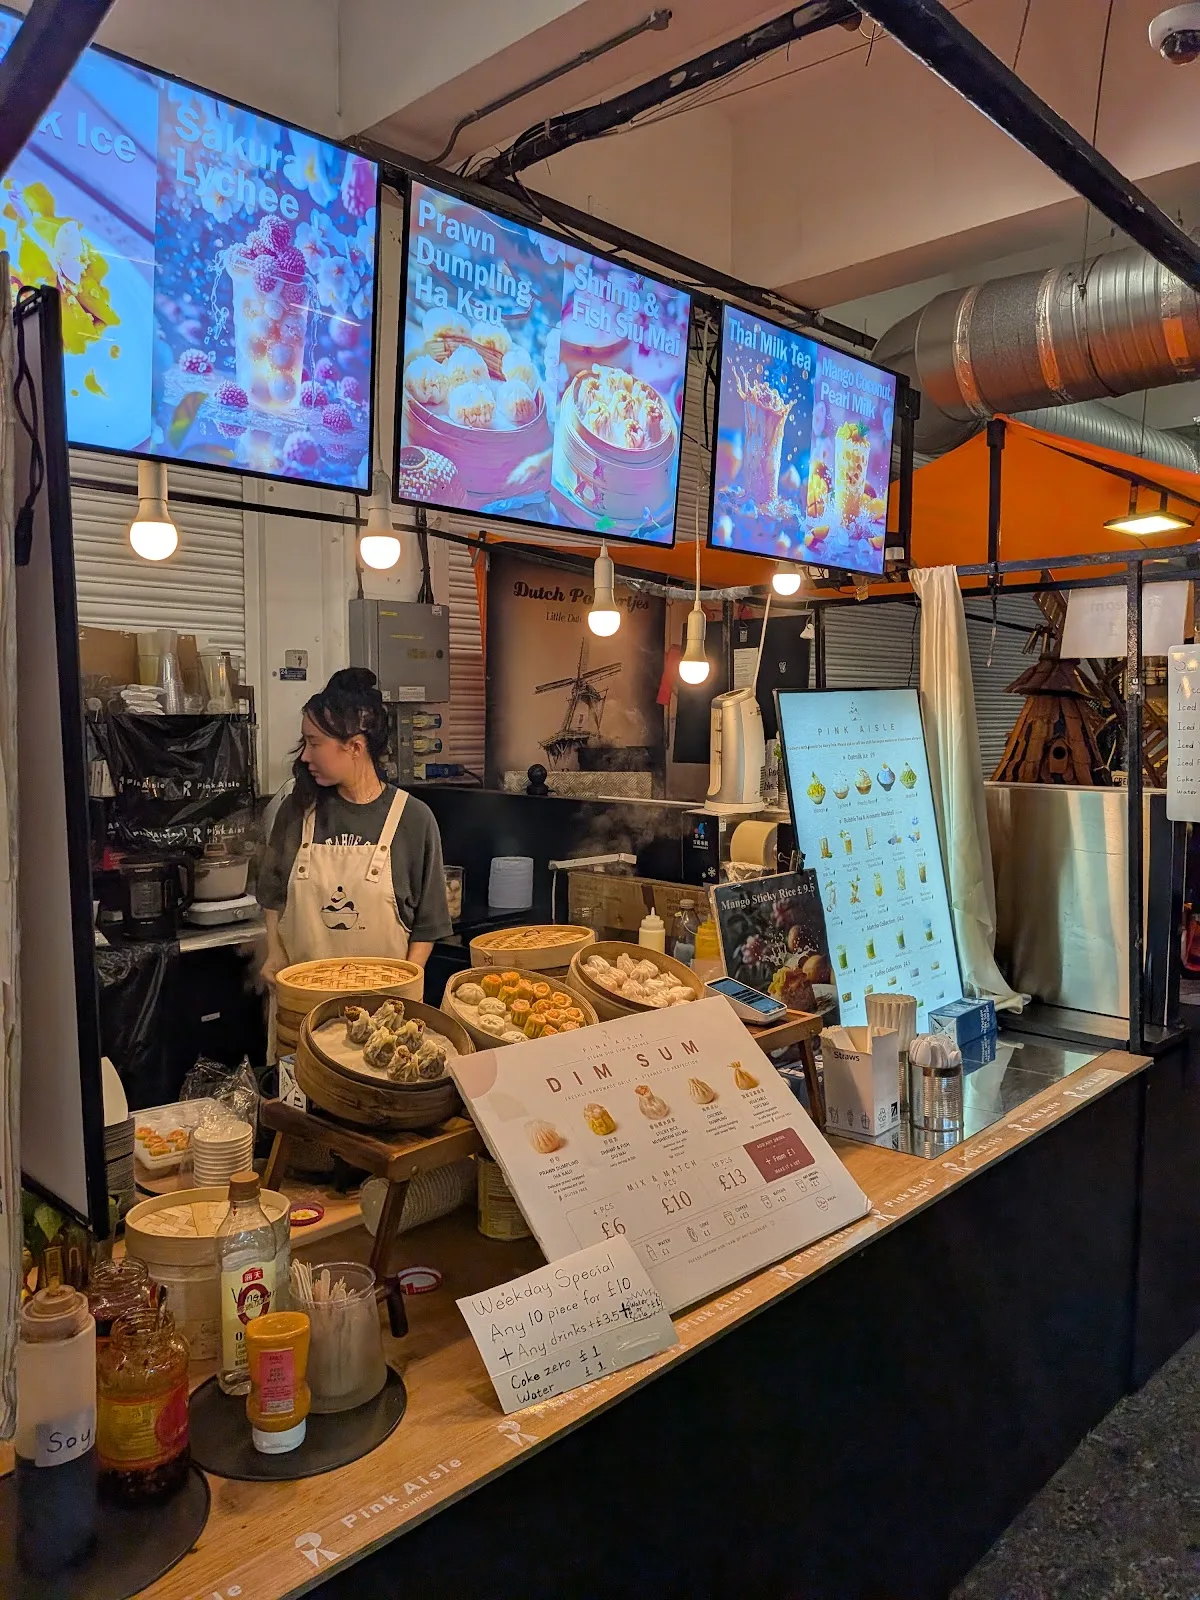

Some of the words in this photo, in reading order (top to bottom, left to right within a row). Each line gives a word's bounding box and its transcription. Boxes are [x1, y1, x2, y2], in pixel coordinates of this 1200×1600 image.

[77, 111, 137, 162] Ice
[175, 105, 308, 190] Sakura
[176, 147, 300, 220] Lychee
[418, 199, 495, 254] Prawn
[416, 236, 533, 308] Dumpling
[415, 272, 448, 308] Ha
[457, 286, 503, 326] Kau
[573, 264, 641, 312] Shrimp
[643, 292, 660, 319] &
[572, 298, 611, 333] Fish
[615, 311, 644, 345] Siu
[647, 322, 681, 357] Mai
[728, 317, 757, 350] Thai
[759, 330, 788, 362] Milk
[791, 342, 811, 371] Tea
[822, 356, 853, 388] Mango
[820, 382, 850, 410] Pearl
[852, 393, 876, 419] Milk
[513, 581, 565, 602] Dutch
[817, 725, 849, 735] PINK
[858, 722, 895, 733] AISLE
[721, 897, 750, 911] Mango
[751, 891, 777, 907] Sticky
[779, 887, 796, 900] Rice
[803, 882, 815, 894] 9.5
[546, 1063, 613, 1094] DIM
[636, 1039, 700, 1068] SUM
[834, 1050, 861, 1062] Straws
[720, 1156, 733, 1165] PCS
[773, 1152, 787, 1163] From
[626, 1179, 646, 1192] MIX
[663, 1160, 697, 1177] MATCH
[664, 1178, 677, 1188] PCS
[718, 1168, 747, 1191] £13
[599, 1203, 614, 1213] PCS
[661, 1190, 692, 1215] £10
[884, 1190, 910, 1208] Pink
[909, 1177, 936, 1194] Aisle
[601, 1216, 626, 1239] £6
[792, 1245, 825, 1263] Pink
[472, 1280, 553, 1316] Weekday
[554, 1253, 616, 1292] Special
[490, 1322, 526, 1344] Any
[528, 1309, 543, 1326] 10
[548, 1301, 579, 1325] piece
[583, 1289, 601, 1305] for
[607, 1276, 631, 1298] £10
[678, 1310, 715, 1333] Pink
[716, 1287, 754, 1311] Aisle
[516, 1341, 547, 1362] Any
[511, 1371, 541, 1390] Coke
[543, 1358, 571, 1377] zero
[516, 1383, 555, 1404] Water
[46, 1427, 91, 1453] Soy
[341, 1494, 400, 1529] Pink
[403, 1457, 463, 1496] Aisle
[397, 1489, 434, 1513] LONDON
